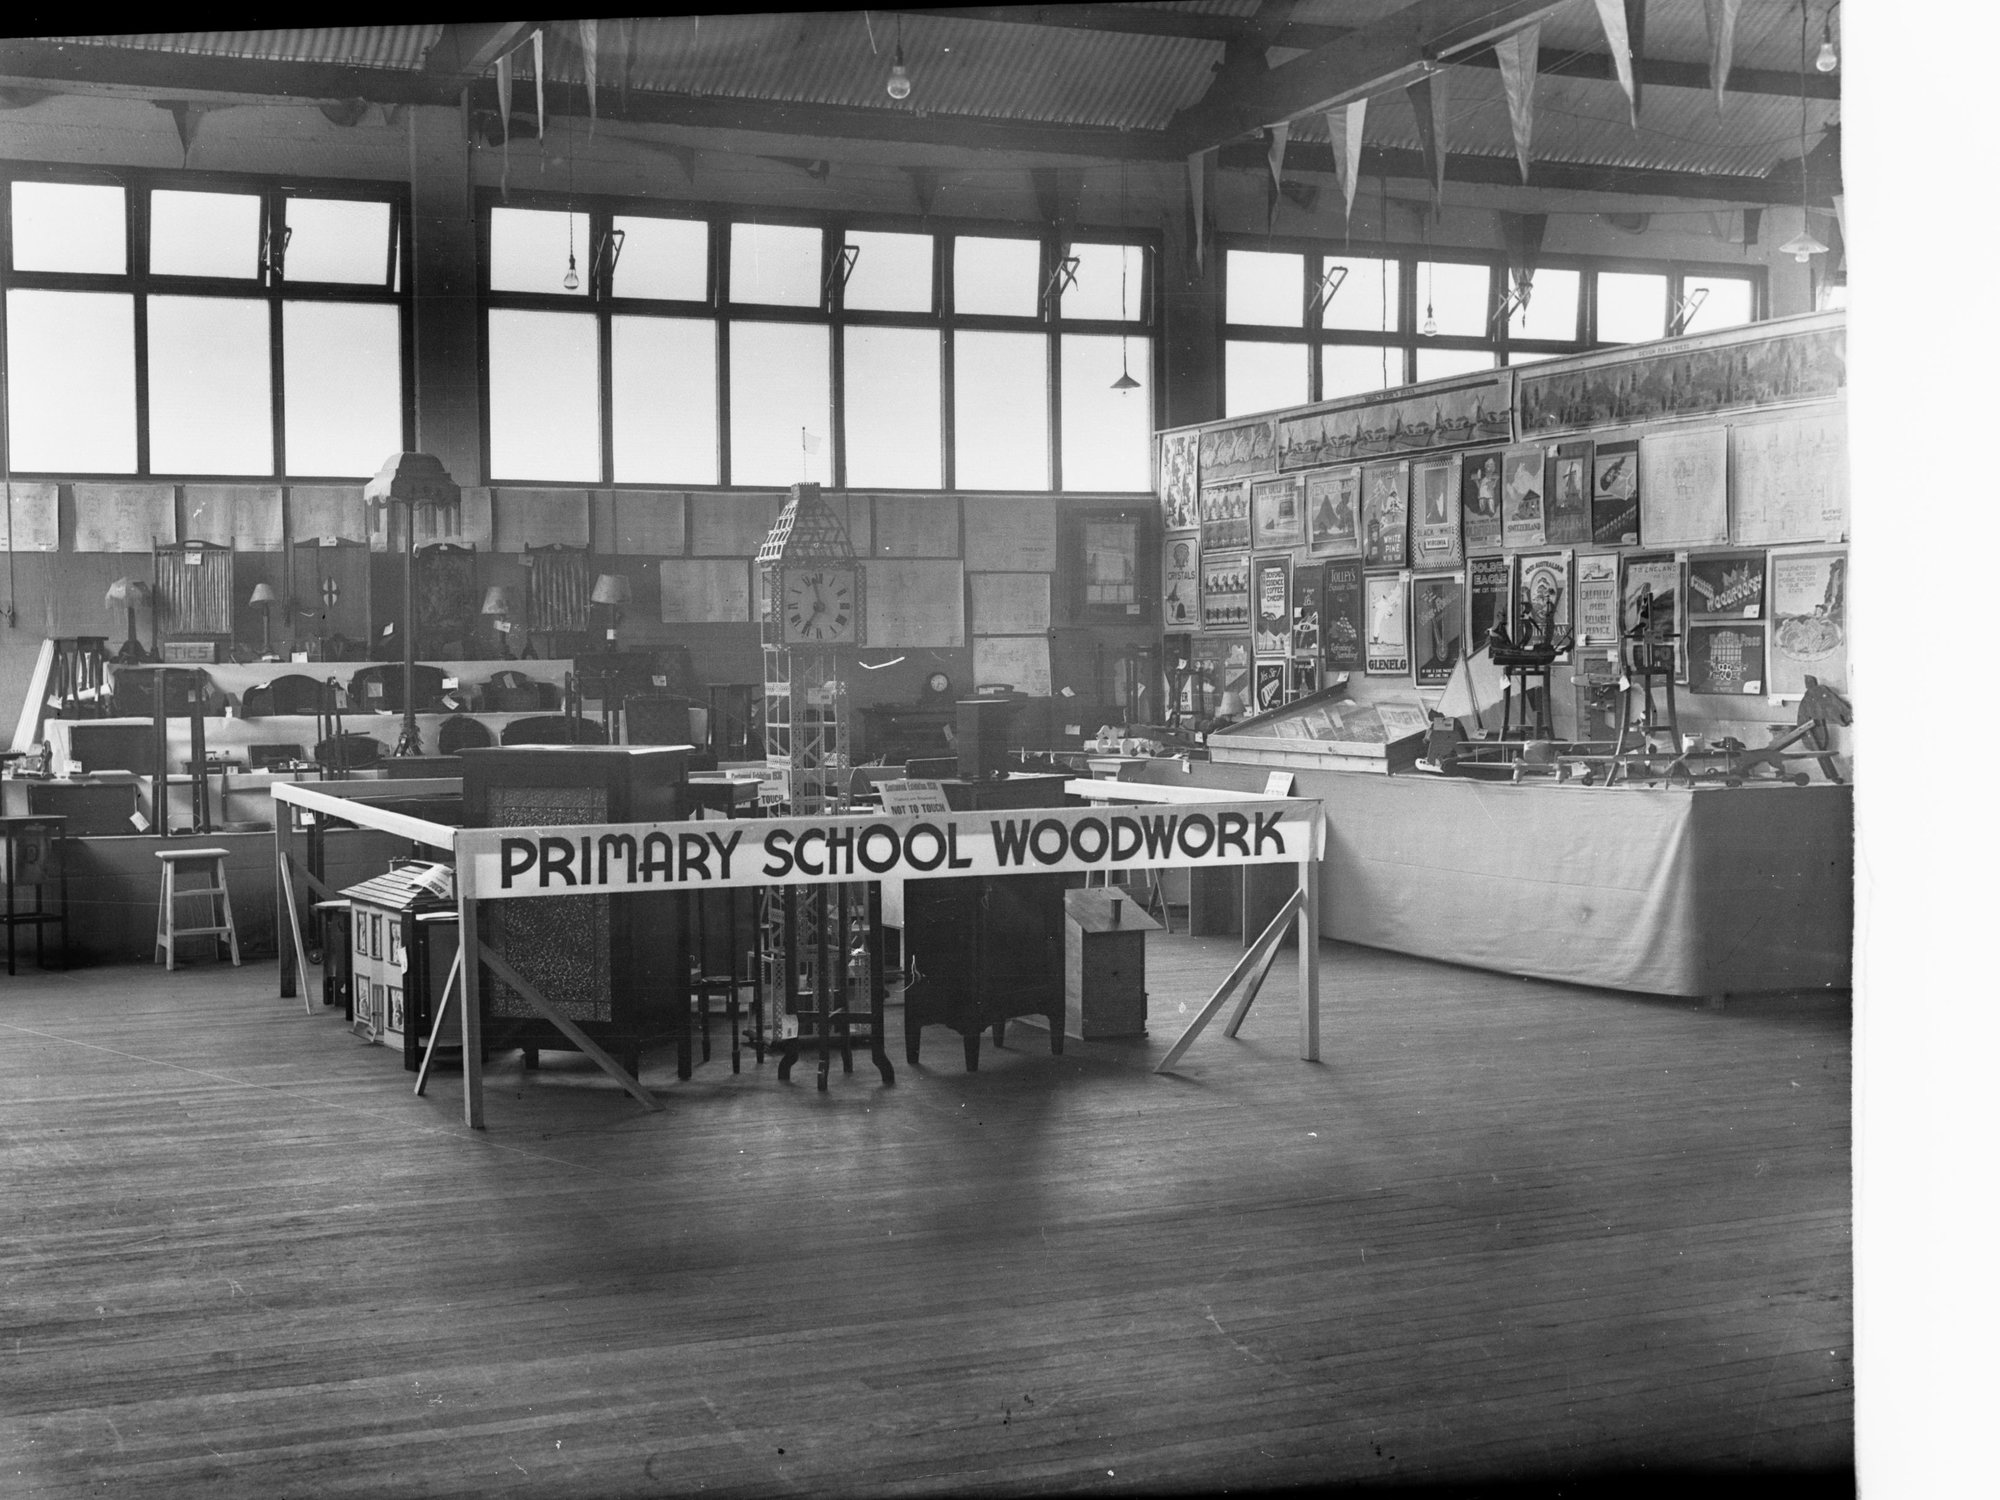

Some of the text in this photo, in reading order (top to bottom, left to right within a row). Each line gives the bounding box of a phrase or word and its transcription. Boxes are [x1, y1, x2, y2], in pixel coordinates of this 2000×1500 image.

[1385, 544, 1401, 553] PINE
[1368, 659, 1407, 671] GLENELG
[761, 795, 783, 804] TOUCH
[891, 803, 946, 815] NOT TO TOUCH
[501, 812, 1285, 889] PRIMARY SCHOOL WOODWORK
